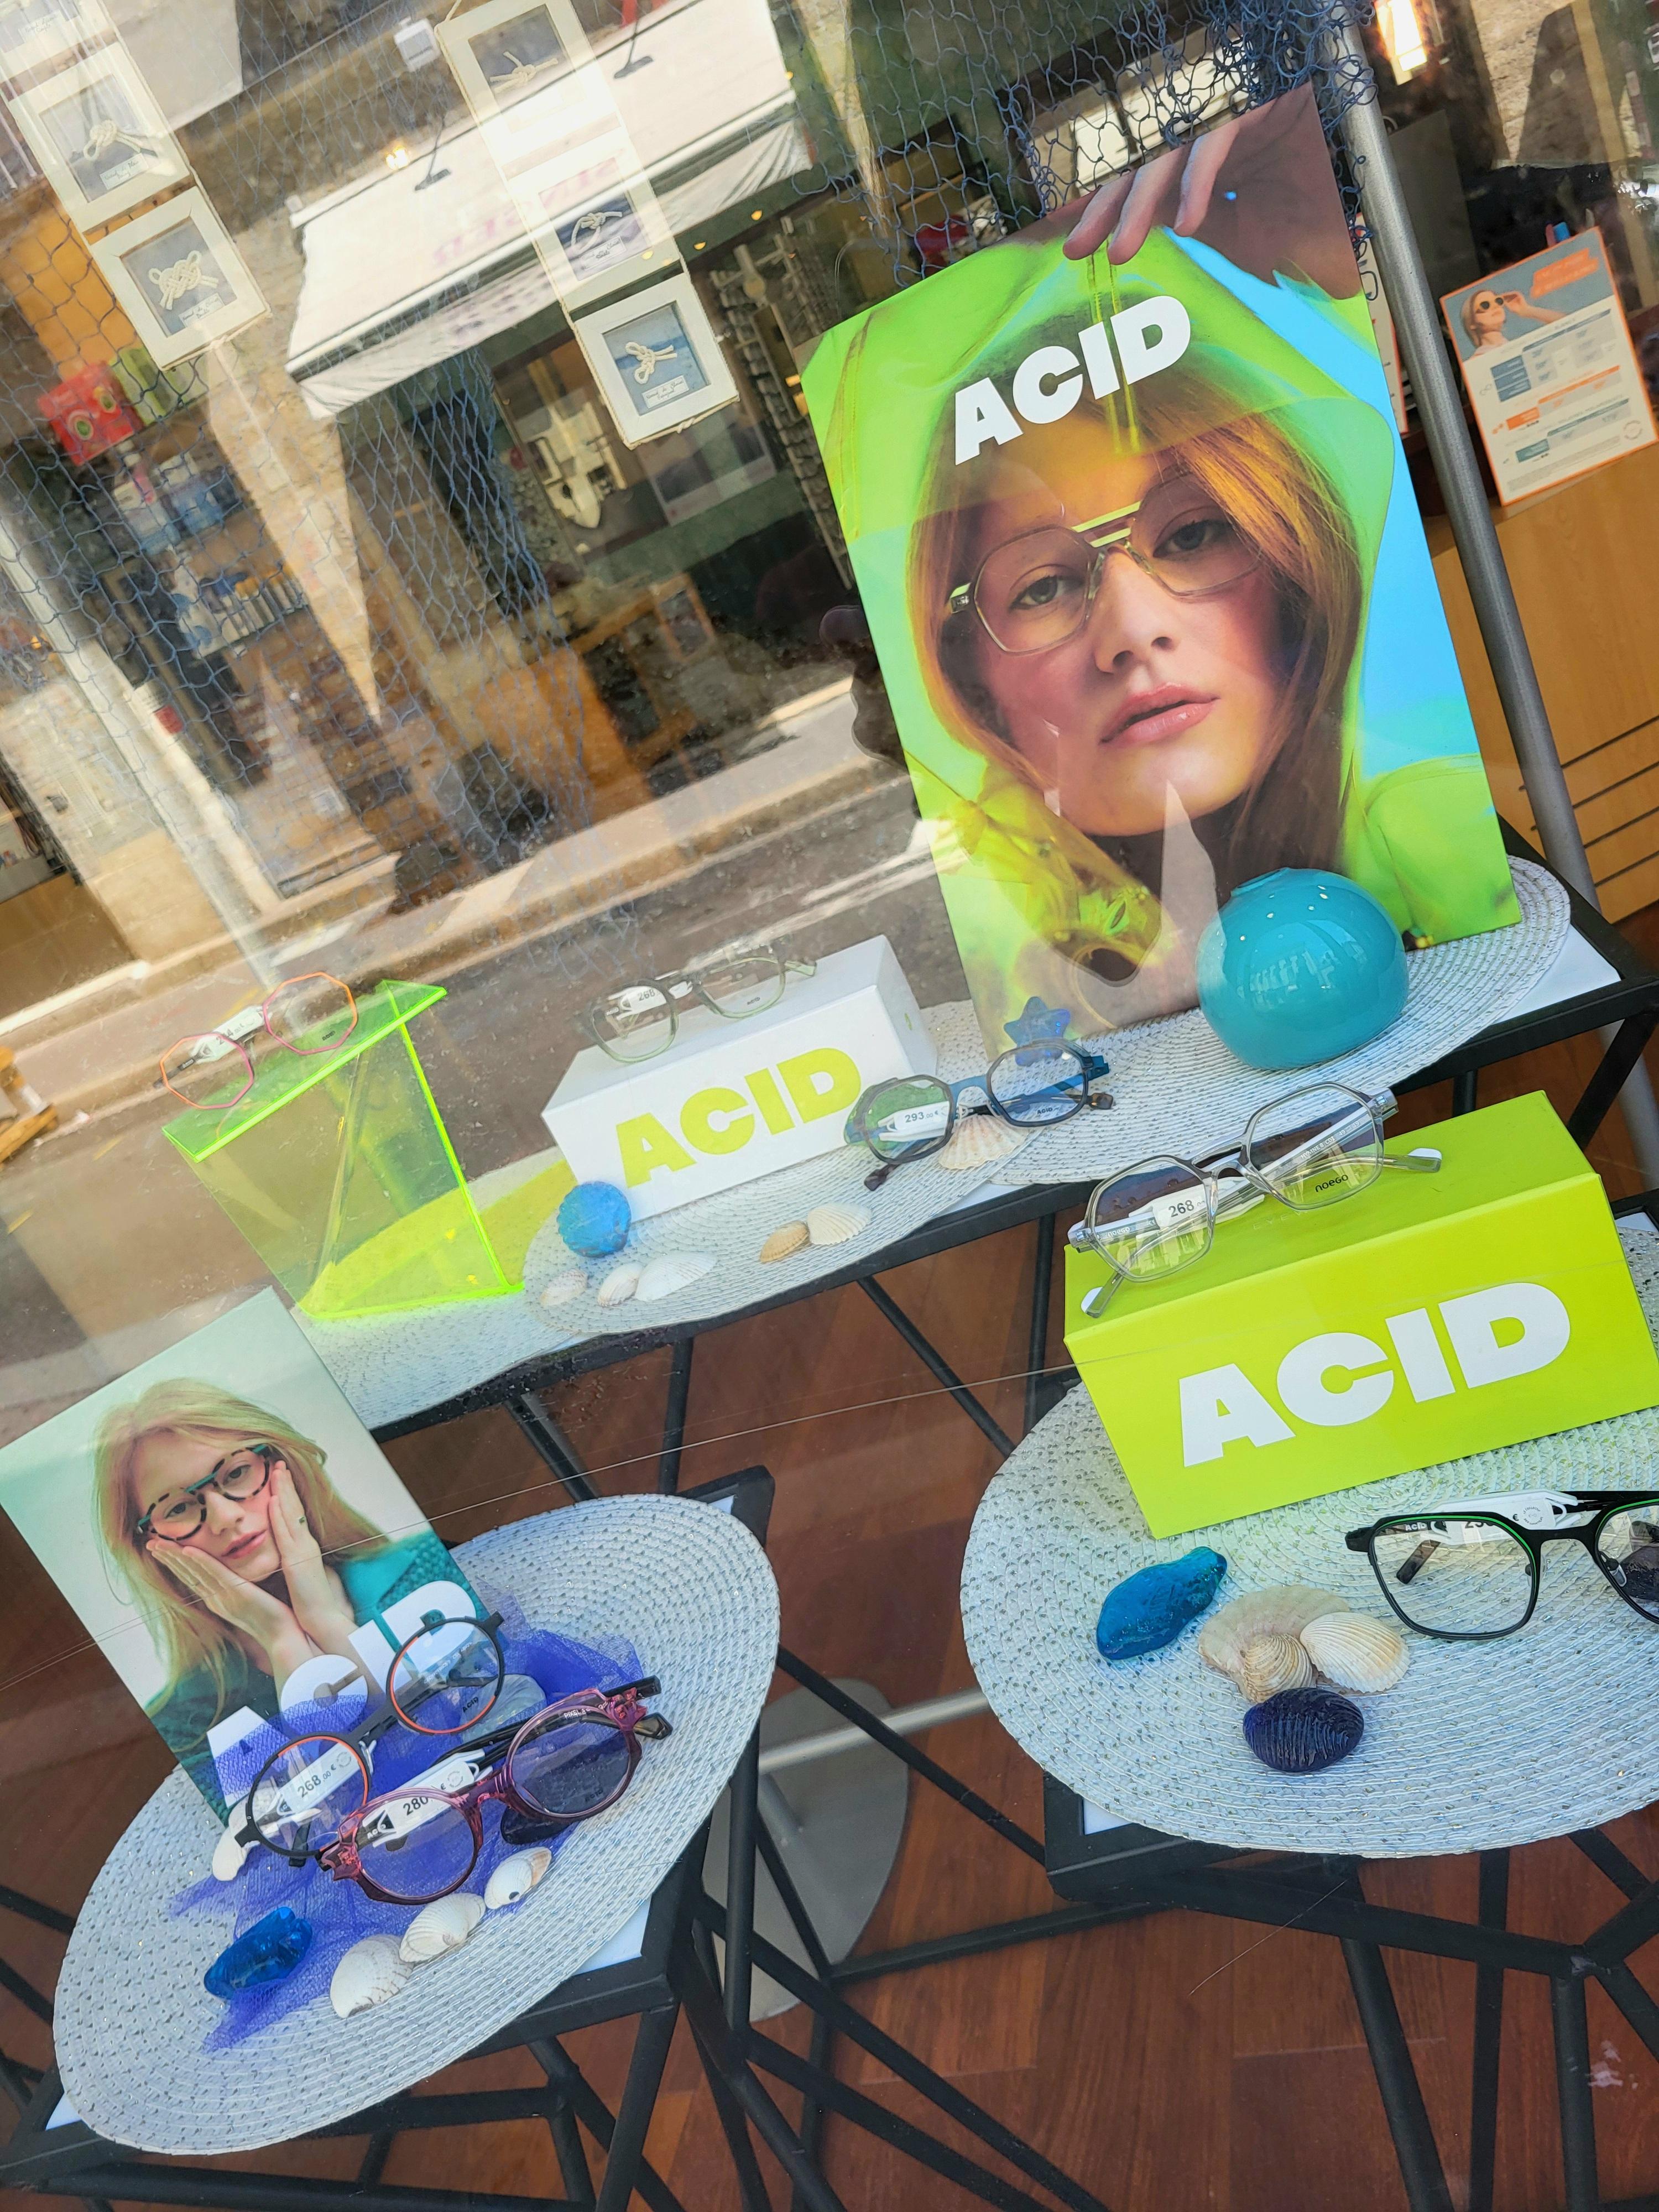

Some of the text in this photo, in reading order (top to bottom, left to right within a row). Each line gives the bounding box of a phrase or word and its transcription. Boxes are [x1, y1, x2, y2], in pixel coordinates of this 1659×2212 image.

[956, 295, 1191, 465] ACID
[637, 989, 656, 1001] 268
[616, 1047, 861, 1188] ACID
[1180, 1282, 1571, 1467] ACID
[1405, 1522, 1427, 1531] ACID
[207, 1580, 478, 1808] ACID
[462, 1696, 479, 1713] ACID
